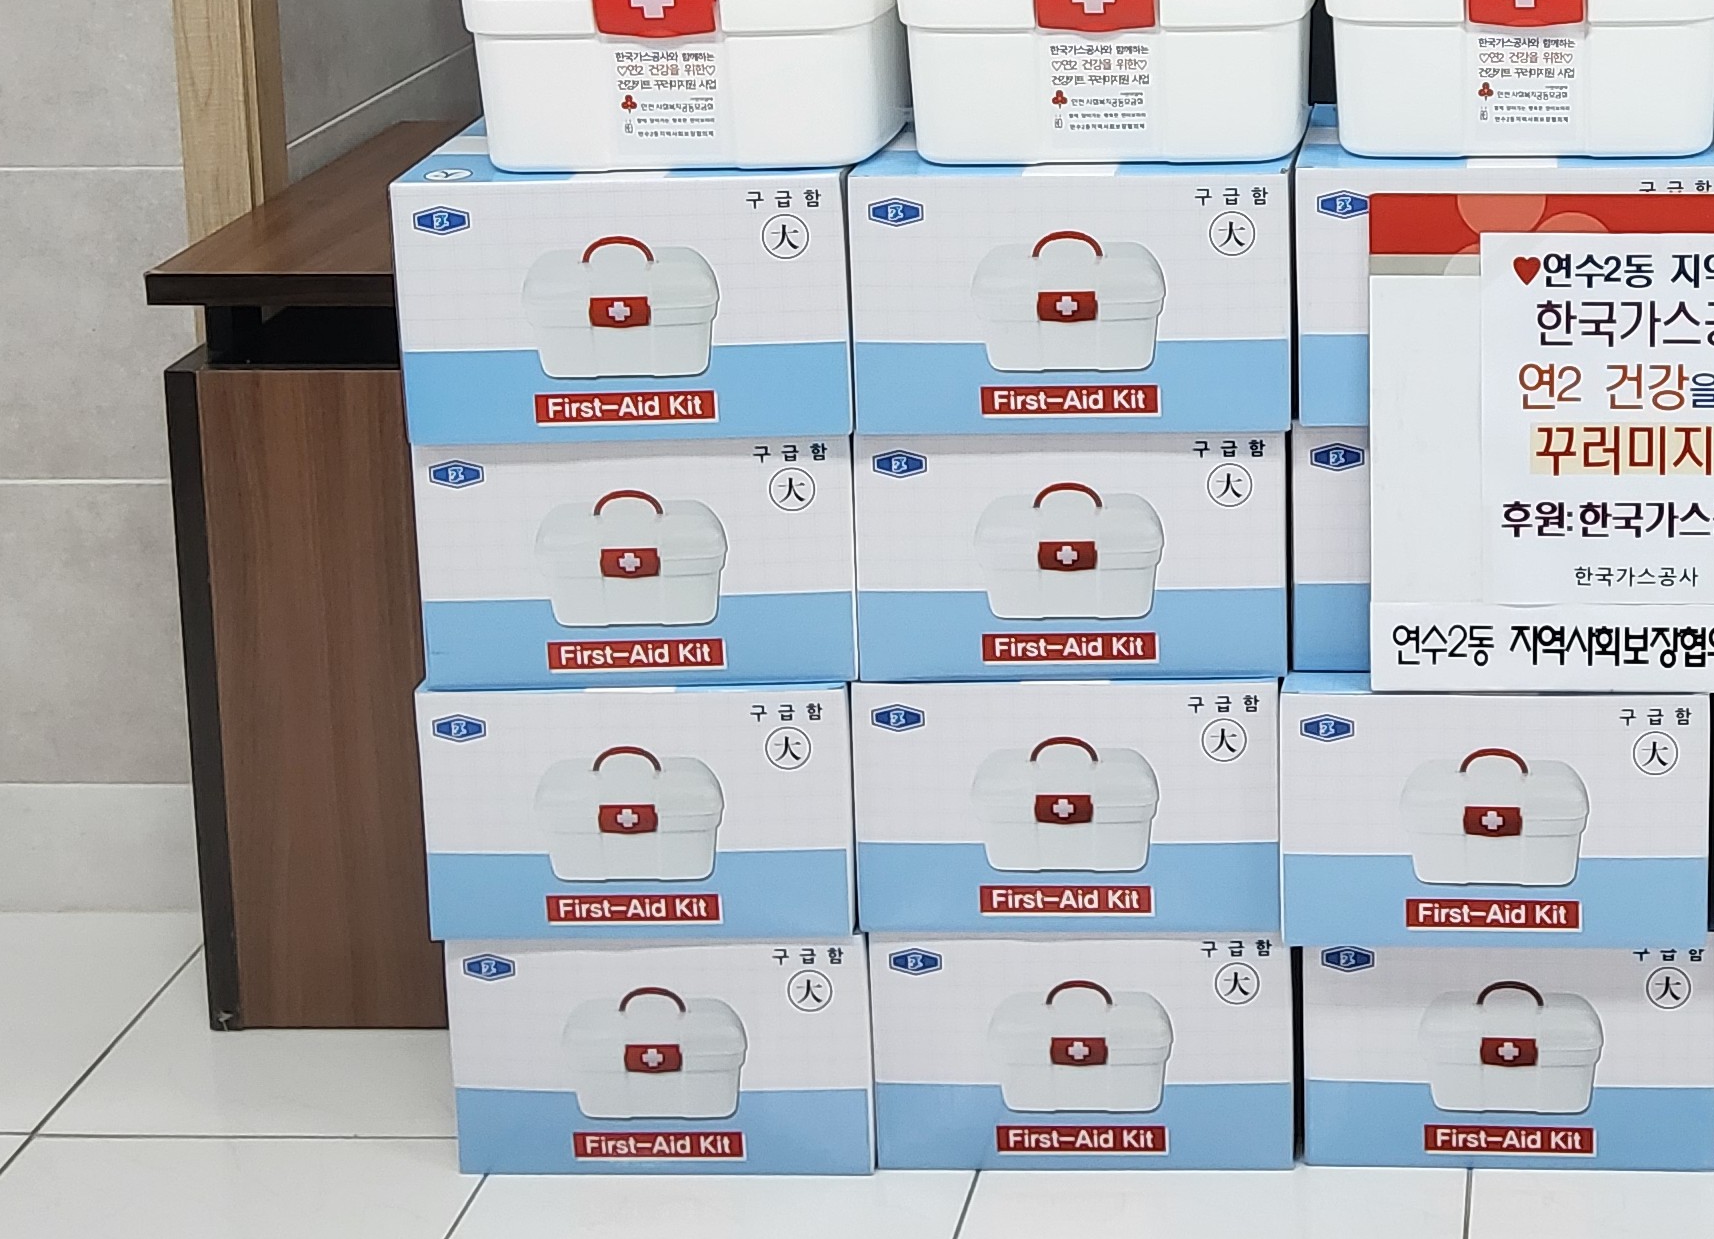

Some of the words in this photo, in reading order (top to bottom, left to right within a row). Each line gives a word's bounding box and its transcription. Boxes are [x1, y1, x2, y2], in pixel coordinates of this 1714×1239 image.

[770, 223, 800, 251] 大
[1218, 220, 1246, 248] 大
[1542, 253, 1655, 289] 연수2동
[993, 389, 1104, 411] First-Aid
[1113, 388, 1146, 409] Kit
[1518, 363, 1582, 410] 연2
[547, 395, 660, 419] First-Aid
[668, 394, 703, 416] Kit
[777, 476, 806, 504] 大
[1216, 472, 1243, 499] 大
[1573, 566, 1699, 588] 한국가스공사
[560, 643, 670, 666] First-Aid
[678, 642, 711, 663] Kit
[994, 636, 1103, 658] First-Aid
[1112, 636, 1144, 656] Kit
[1392, 624, 1495, 667] 연수2동
[774, 735, 802, 762] 大
[1210, 727, 1238, 754] 大
[1641, 740, 1669, 767] 大
[558, 898, 667, 918] First-Aid
[675, 898, 708, 918] Kit
[992, 888, 1099, 909] First-Aid
[1107, 889, 1140, 909] Kit
[1418, 902, 1526, 924] First-Aid
[1535, 904, 1567, 925] Kit
[796, 978, 823, 1004] 大
[1223, 971, 1251, 997] 大
[1654, 975, 1682, 1002] 大
[585, 1135, 691, 1154] First-Aid
[700, 1135, 731, 1154] Kit
[1008, 1129, 1114, 1148] First-Aid
[1122, 1129, 1154, 1148] Kit
[1436, 1128, 1542, 1149] First-Aid
[1550, 1130, 1582, 1150] Kit
